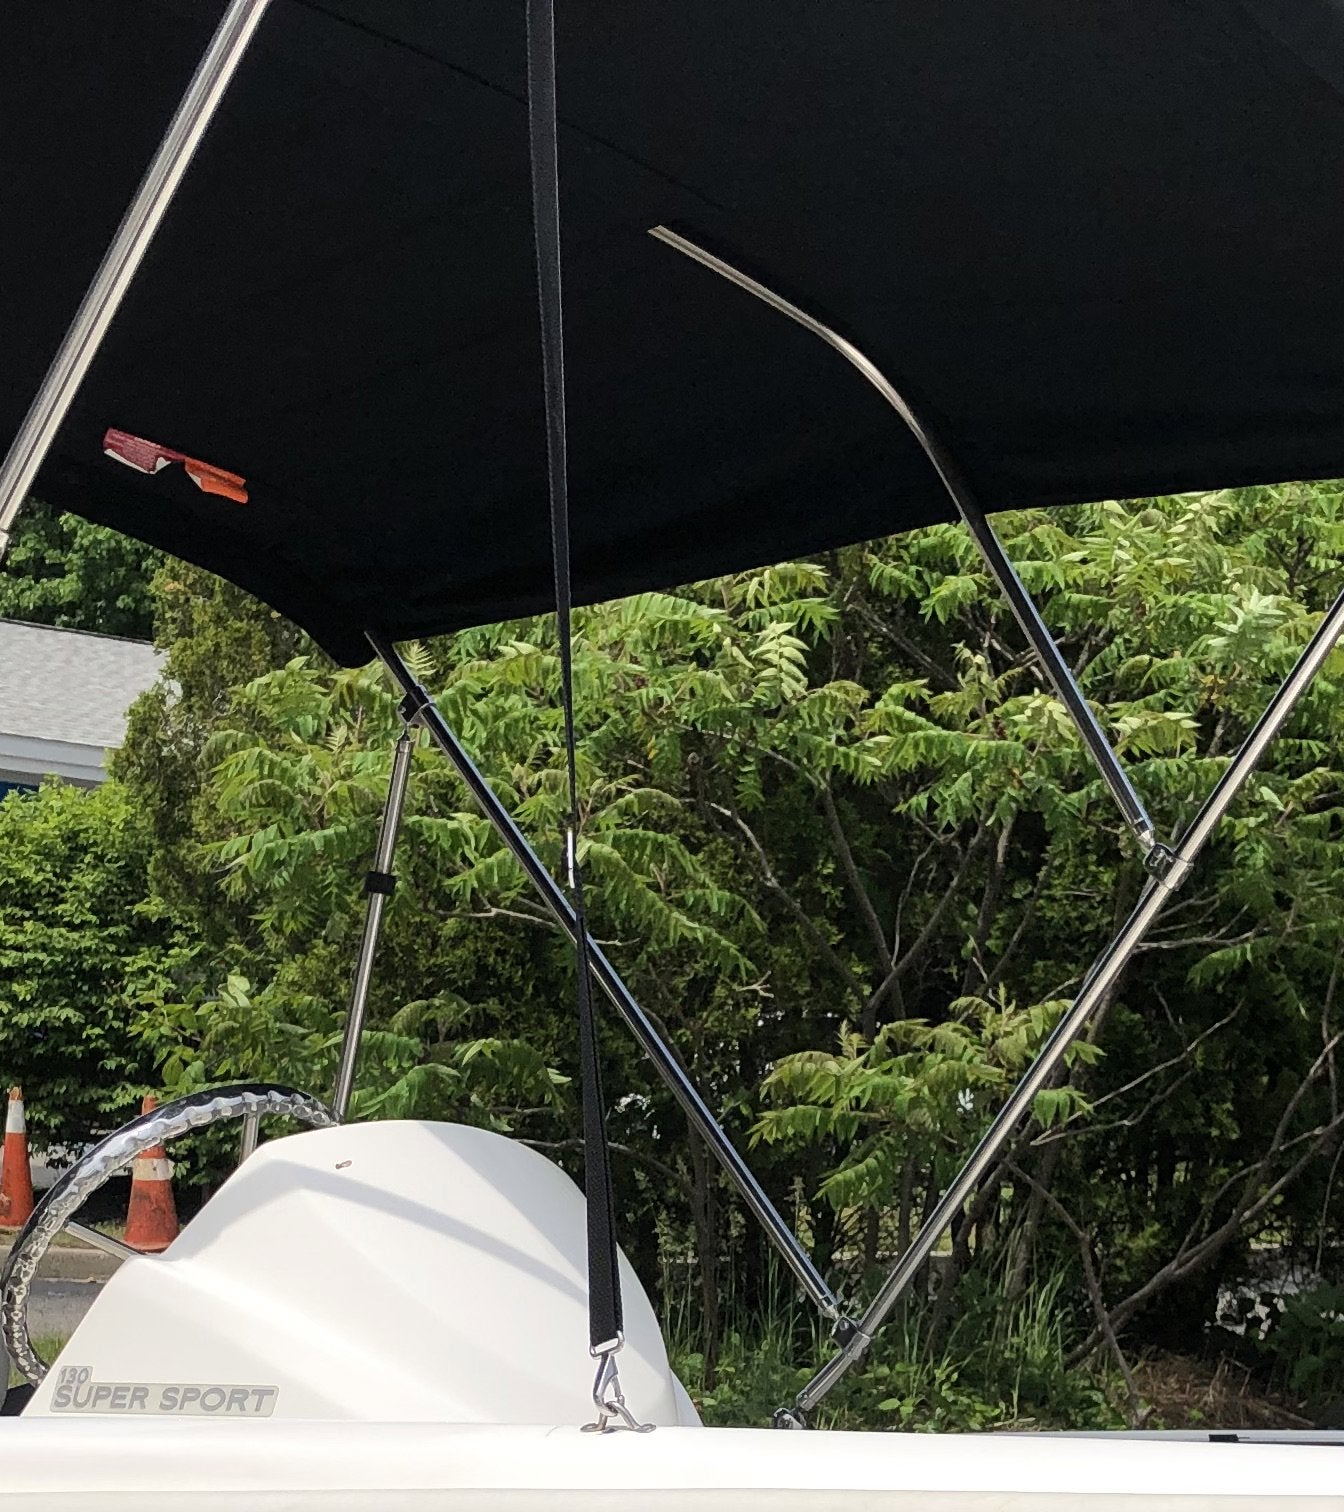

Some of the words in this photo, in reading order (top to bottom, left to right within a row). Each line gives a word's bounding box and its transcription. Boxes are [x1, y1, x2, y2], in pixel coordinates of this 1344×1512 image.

[59, 1367, 89, 1385] 130
[55, 1384, 150, 1410] SUPER
[158, 1387, 275, 1412] SPORT
